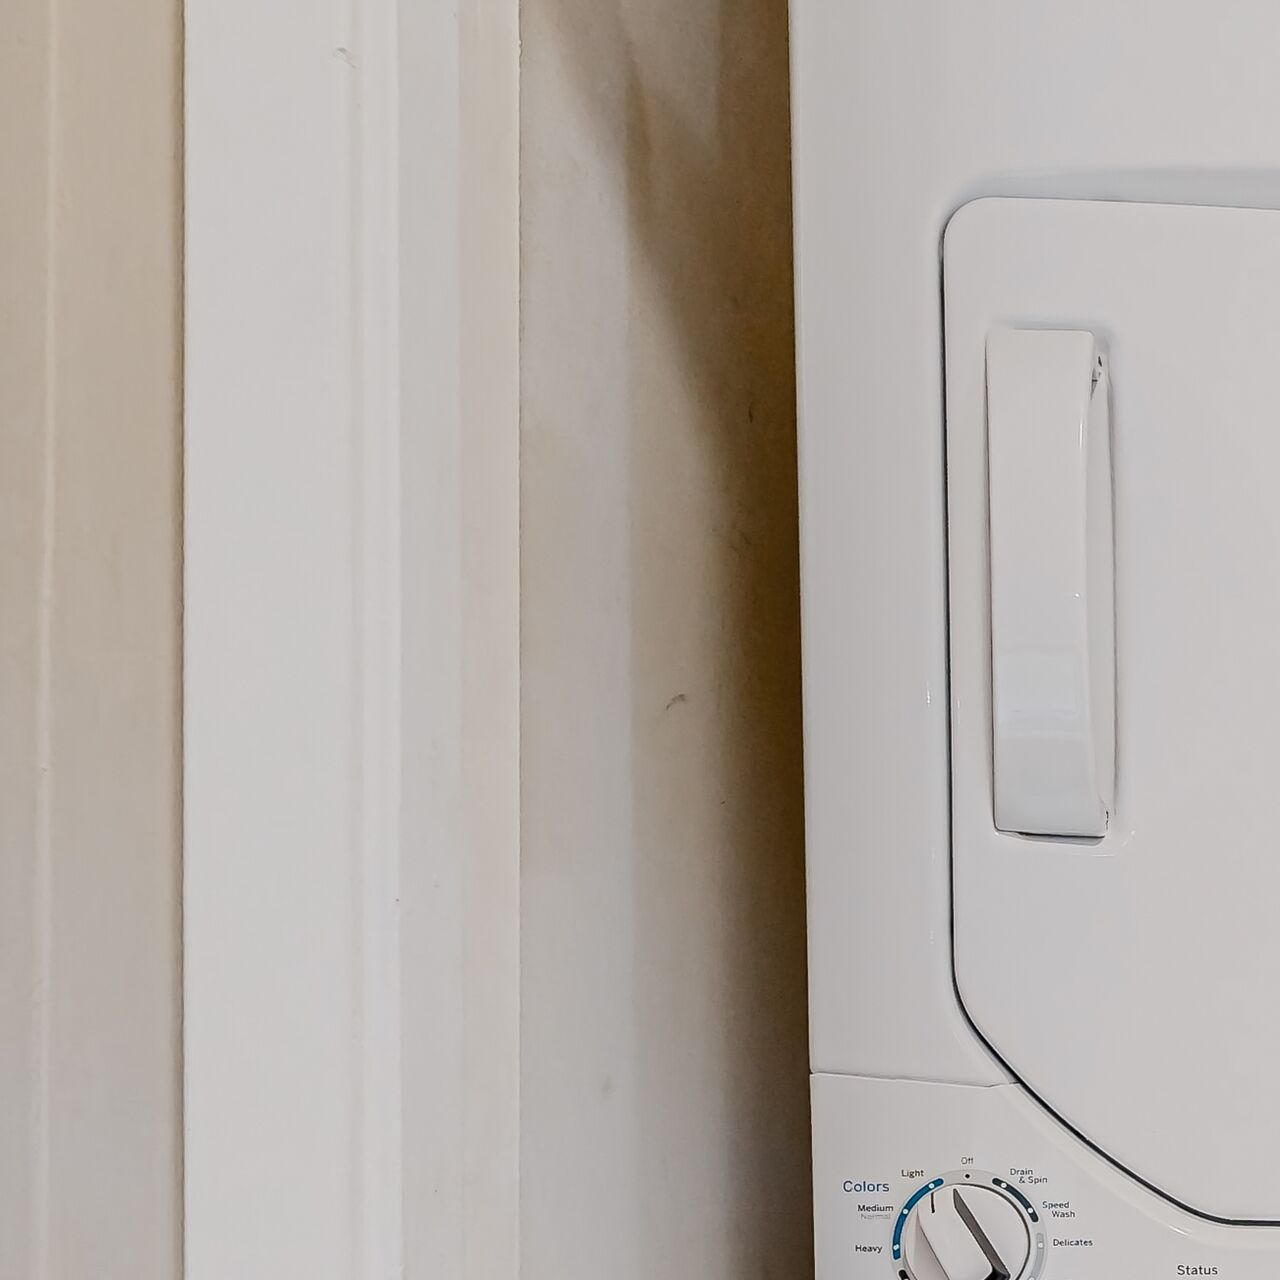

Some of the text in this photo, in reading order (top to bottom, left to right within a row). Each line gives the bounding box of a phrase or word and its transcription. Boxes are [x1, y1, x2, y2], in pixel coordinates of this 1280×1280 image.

[901, 1170, 924, 1178] Light
[1010, 1168, 1033, 1176] Drain
[1028, 1175, 1048, 1185] Spin
[843, 1181, 890, 1192] Colors
[857, 1204, 894, 1212] Medium
[1042, 1201, 1070, 1210] Speed
[1052, 1210, 1076, 1218] Wash
[1052, 1239, 1093, 1247] Delicates
[855, 1244, 882, 1253] Heavy
[1177, 1264, 1218, 1276] Status
